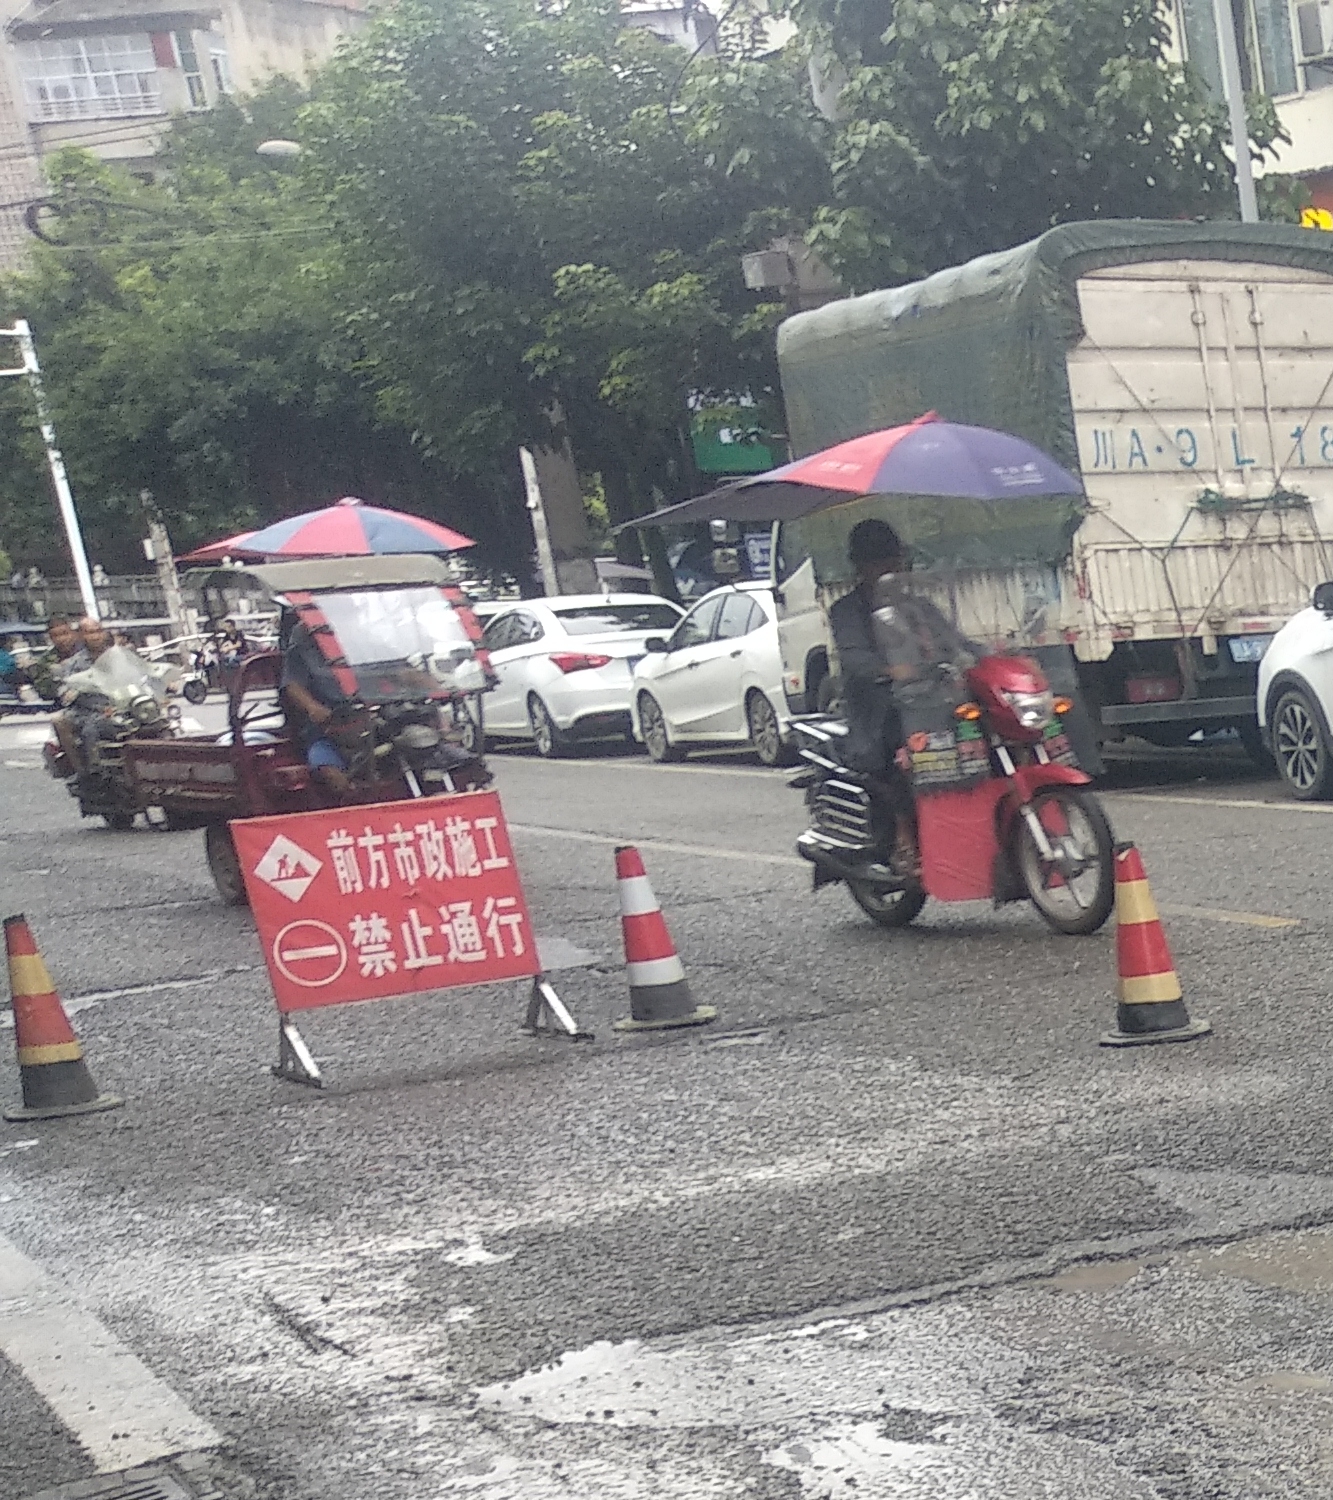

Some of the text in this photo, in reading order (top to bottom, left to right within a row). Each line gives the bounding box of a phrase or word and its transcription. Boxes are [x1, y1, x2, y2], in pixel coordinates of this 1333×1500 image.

[326, 816, 510, 895] 前方市政施工
[348, 896, 527, 978] 禁止通行
